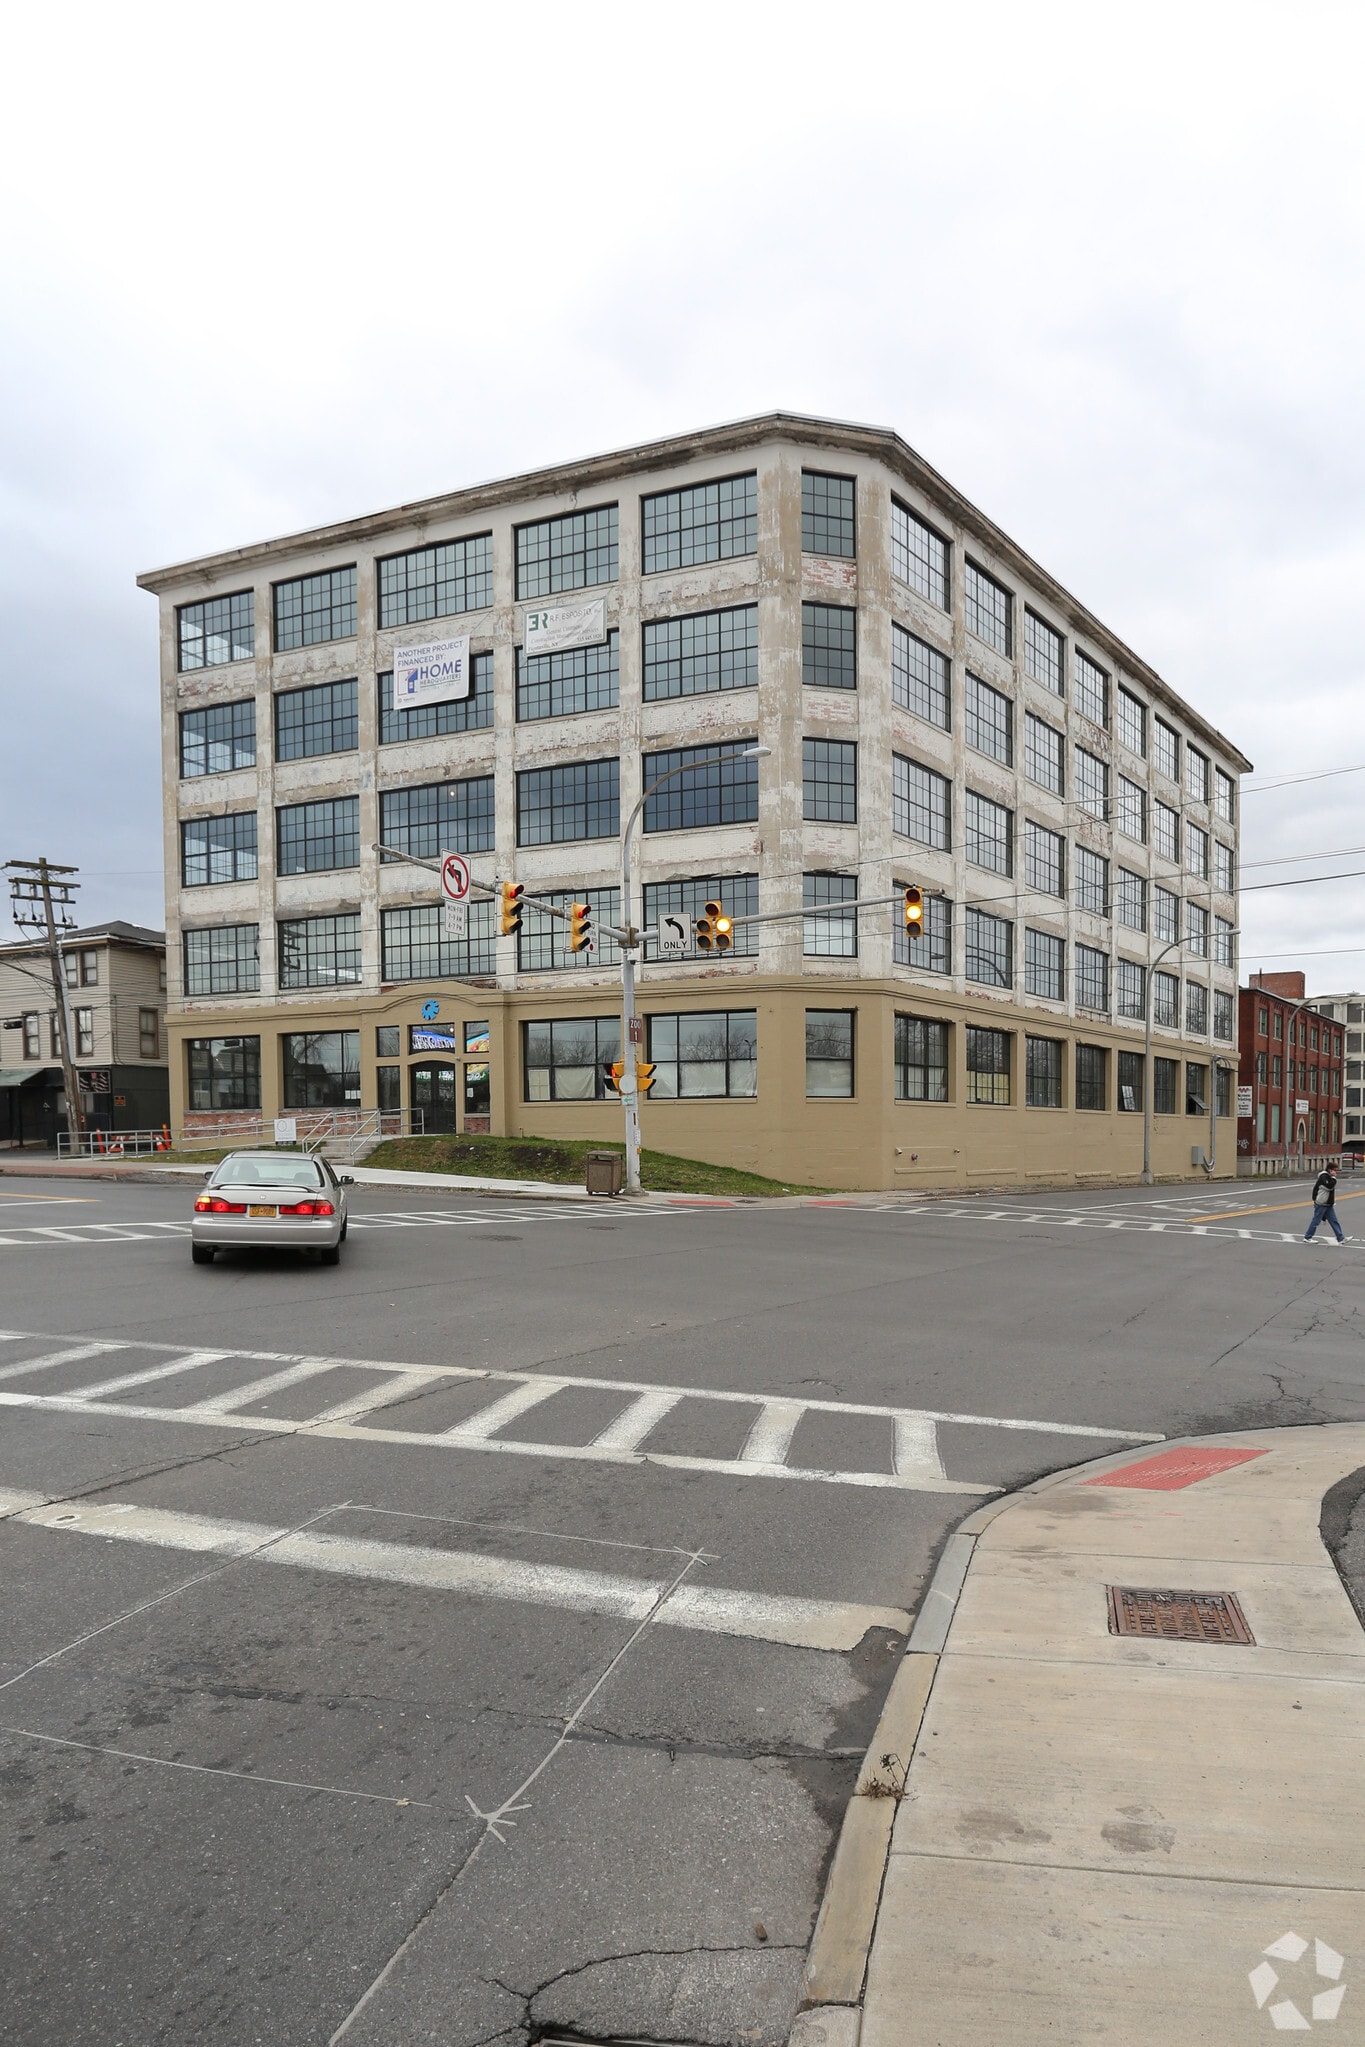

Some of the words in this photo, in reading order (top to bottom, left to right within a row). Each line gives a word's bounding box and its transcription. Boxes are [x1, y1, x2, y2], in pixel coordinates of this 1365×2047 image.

[397, 647, 431, 659] ANOTHER
[432, 640, 464, 653] PROJECT
[398, 655, 434, 667] FINANCED
[435, 653, 447, 661] BY:
[420, 659, 462, 680] HOME
[420, 673, 462, 685] HEADQUARTERS
[663, 941, 688, 949] ONLY
